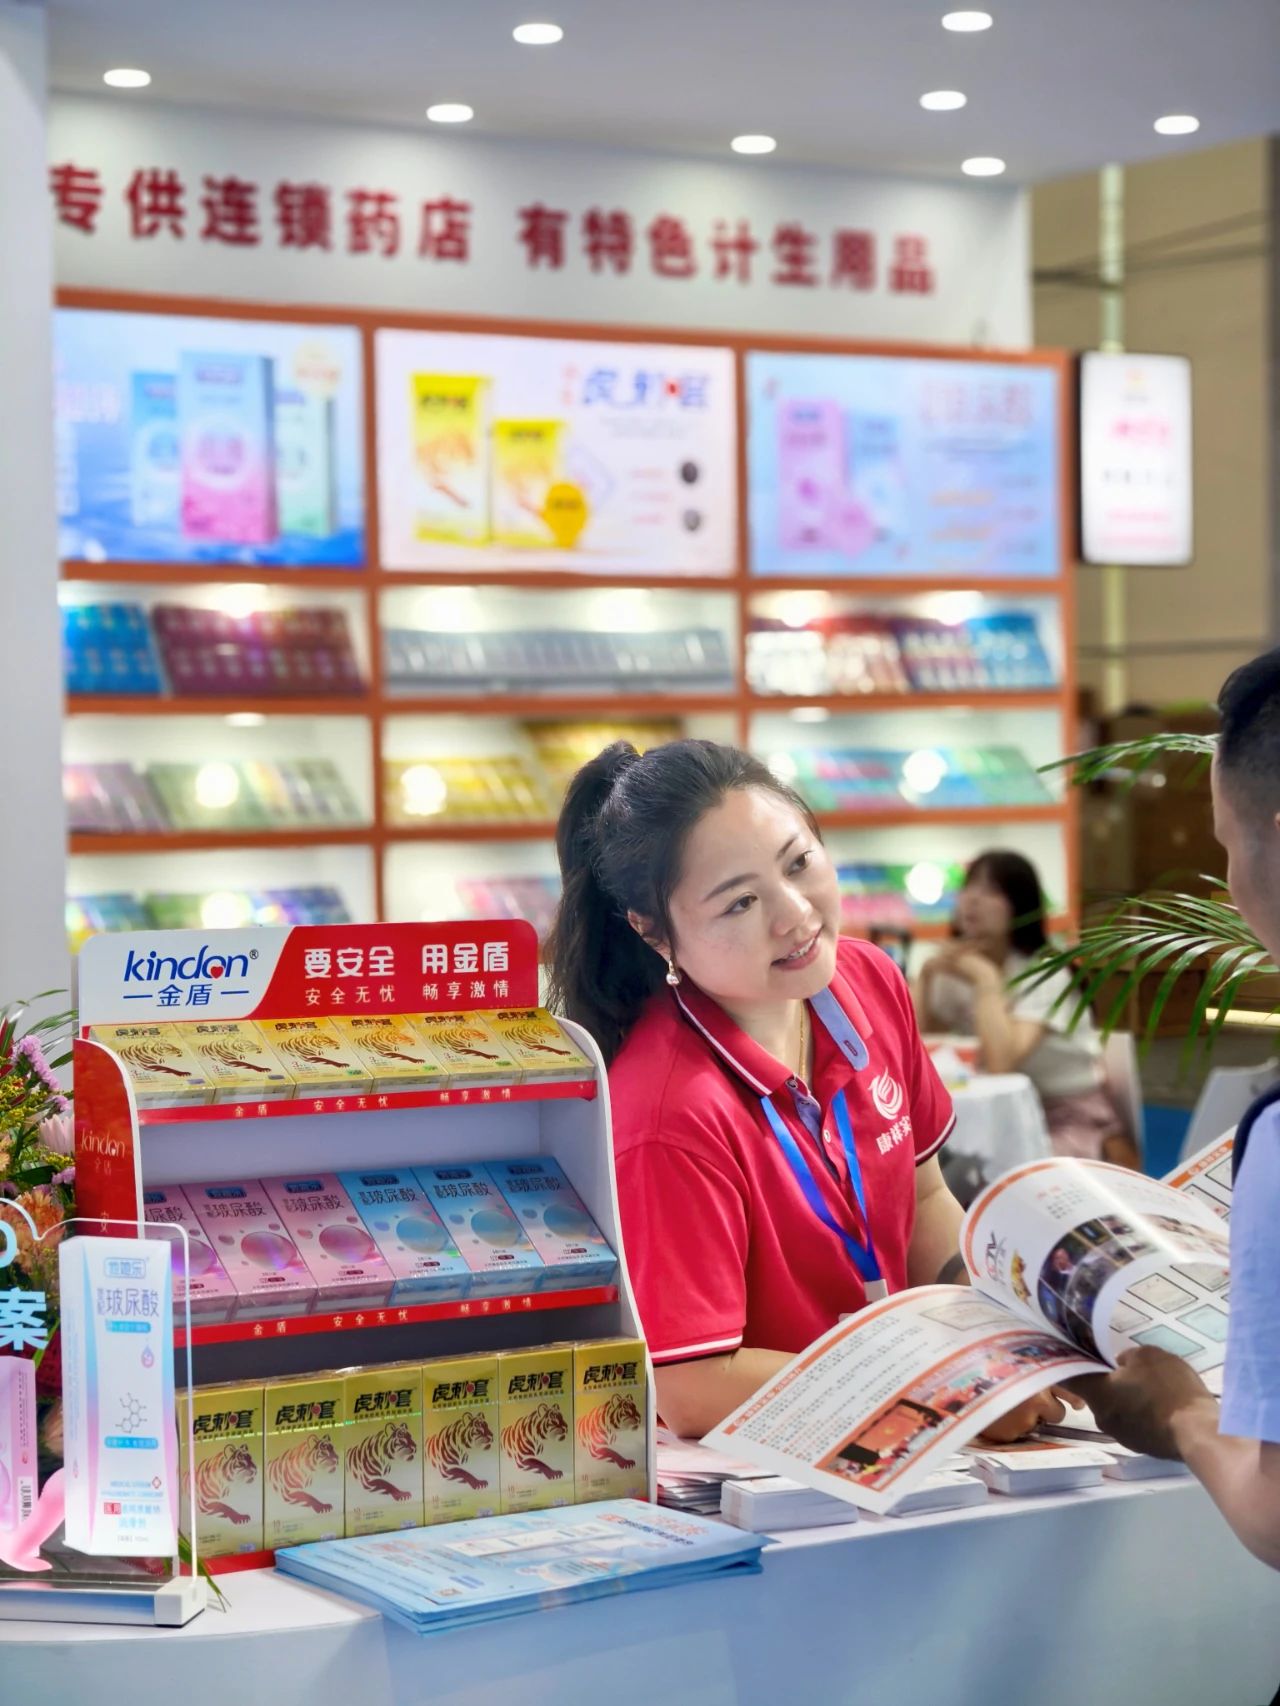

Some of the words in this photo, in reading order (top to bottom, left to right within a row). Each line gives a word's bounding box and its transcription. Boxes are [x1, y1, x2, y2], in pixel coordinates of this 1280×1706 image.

[49, 162, 472, 264] 专供连锁药店
[304, 946, 395, 979] 要安全
[422, 942, 508, 974] 用金盾
[156, 984, 213, 1007] 金盾
[305, 985, 395, 1006] 安全无忧
[422, 980, 508, 1001] 畅享激情
[235, 1104, 268, 1117] 金盾
[314, 1096, 388, 1112] 安全无忧
[254, 1321, 287, 1335] 金盾
[333, 1309, 409, 1328] 安全无忧
